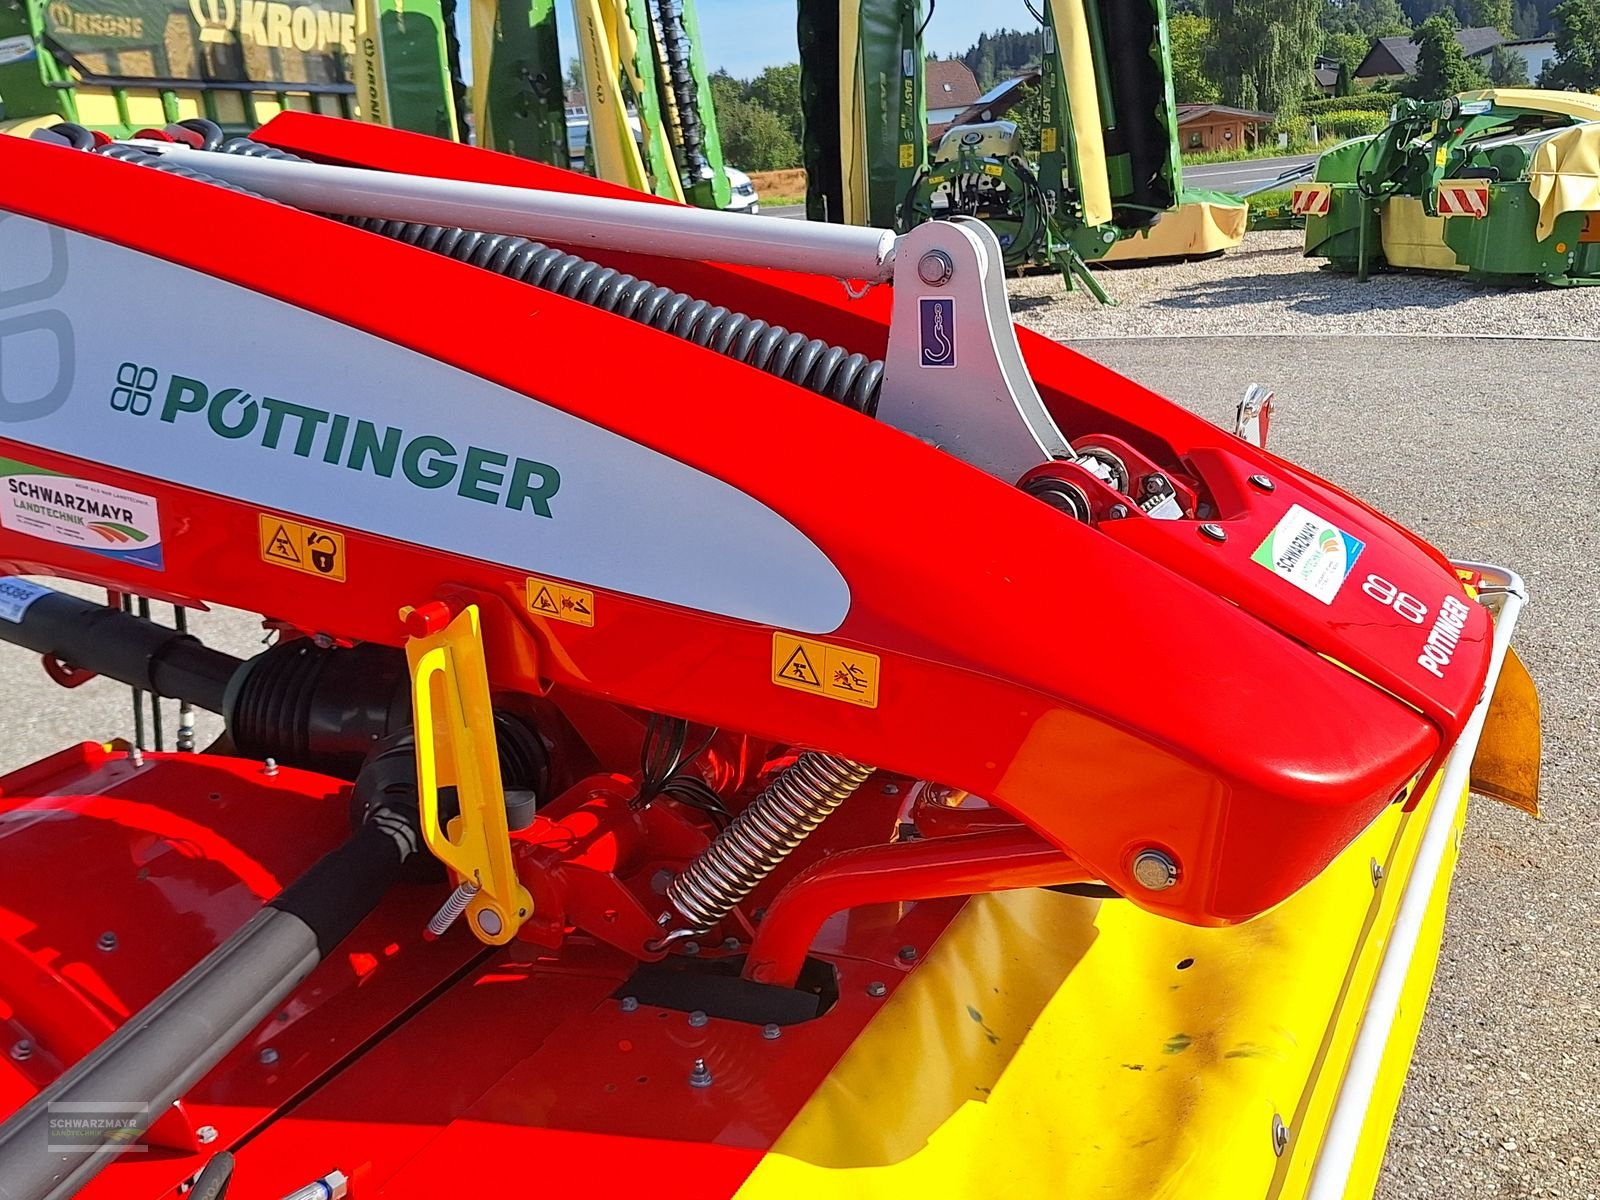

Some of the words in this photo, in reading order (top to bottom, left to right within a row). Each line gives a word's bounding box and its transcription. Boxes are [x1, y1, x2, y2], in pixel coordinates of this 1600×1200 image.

[241, 1, 356, 54] KRONE
[160, 374, 561, 519] PÖTTINGER
[8, 478, 133, 524] SCHWARZMAYR
[13, 498, 86, 526] LANDTECHNIK
[1275, 522, 1320, 573] SCHWARZMAYR
